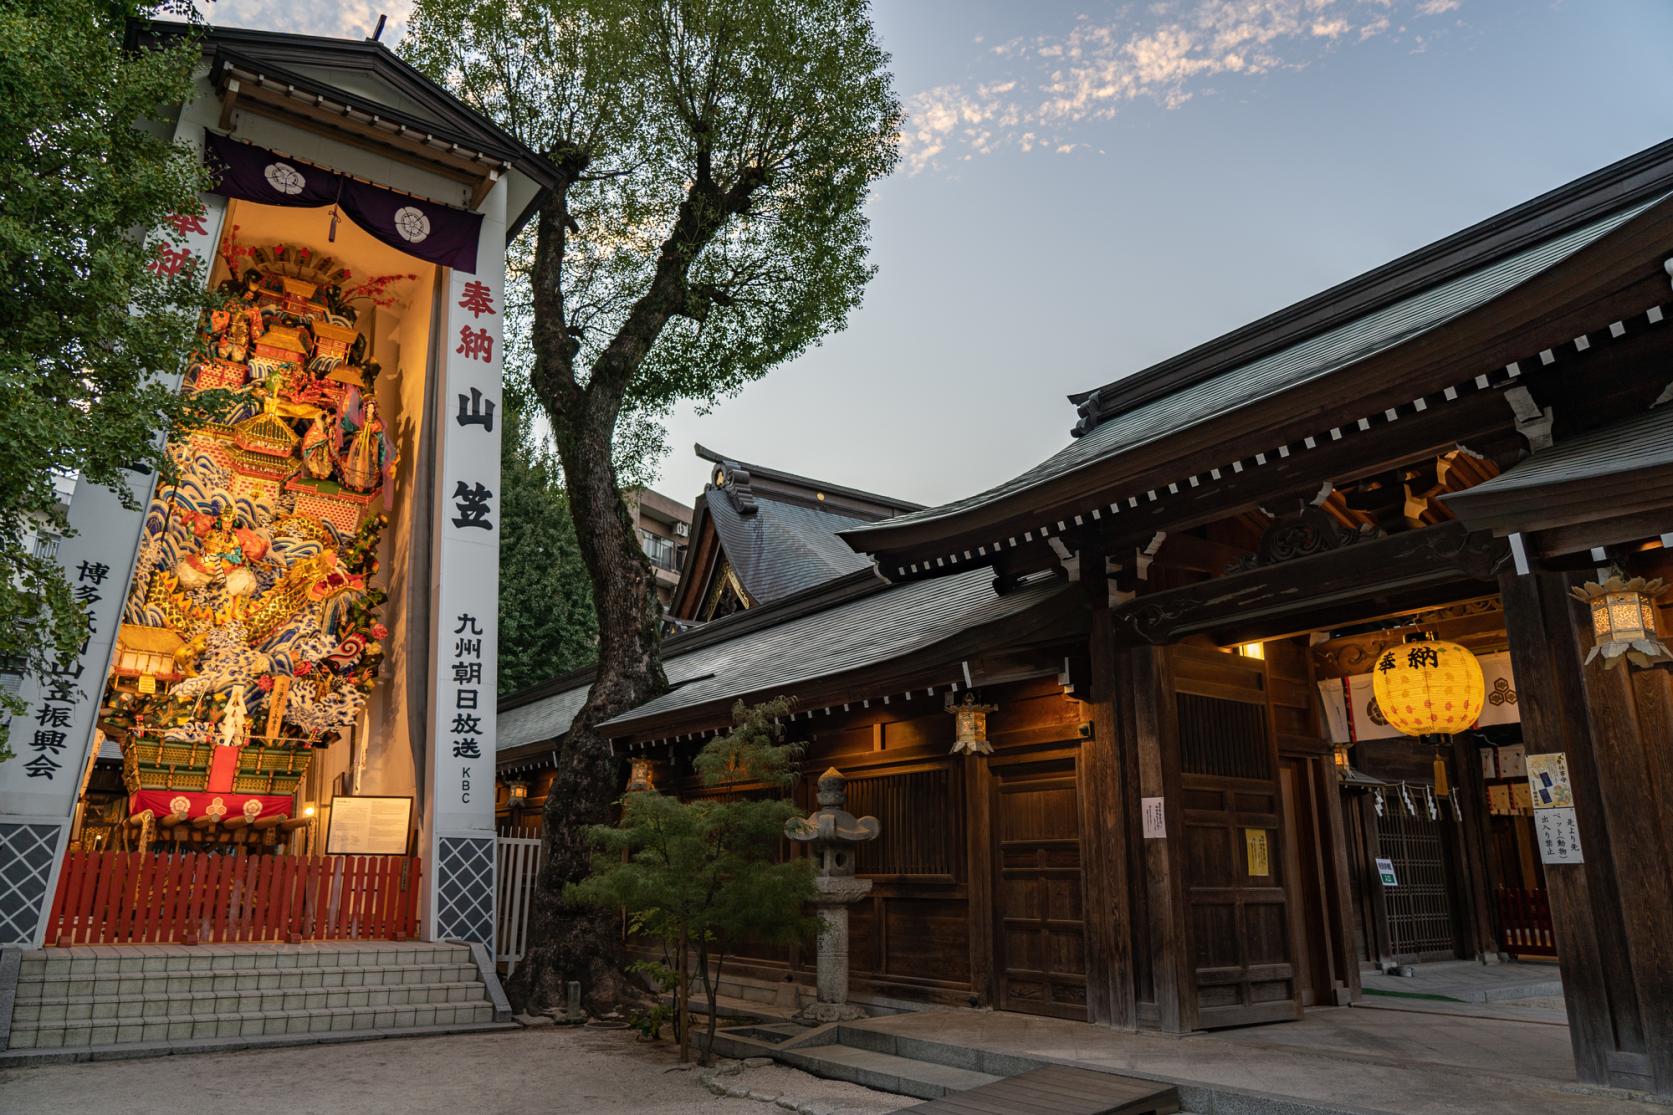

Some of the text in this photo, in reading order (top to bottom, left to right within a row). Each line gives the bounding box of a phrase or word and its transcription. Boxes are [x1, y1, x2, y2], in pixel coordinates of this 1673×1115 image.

[23, 560, 110, 780] 博多山笠振興会
[1378, 647, 1439, 675] 奉納
[450, 613, 483, 759] 九州朝日放送
[462, 767, 471, 803] KBC
[1541, 815, 1555, 856] 出入り禁止
[1566, 818, 1580, 851] 是より先
